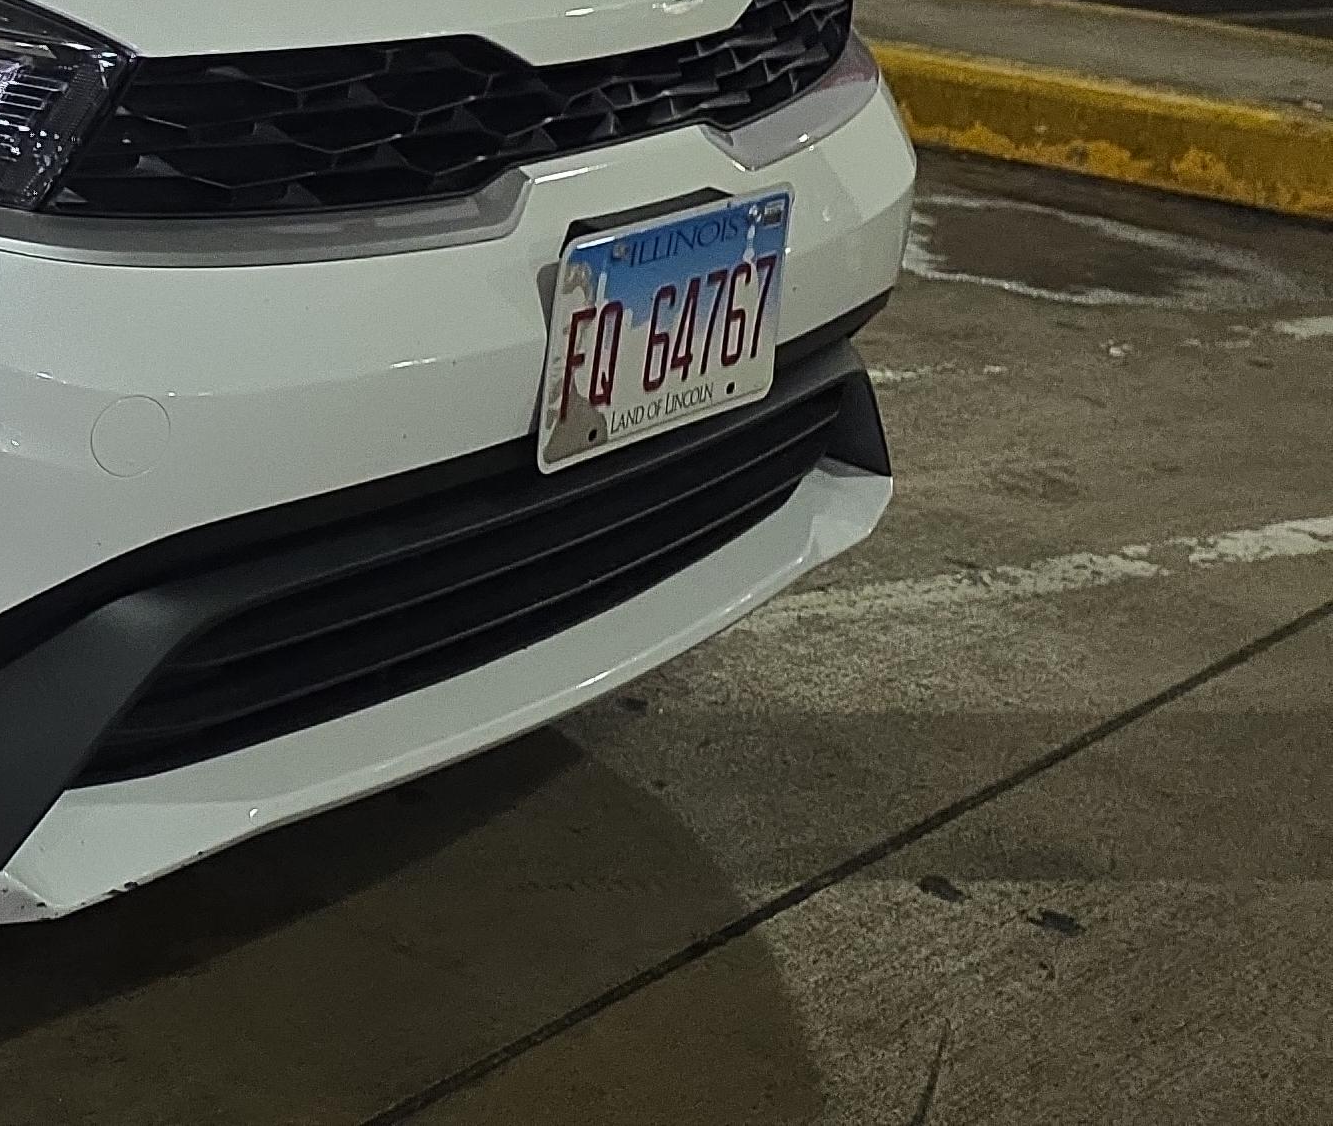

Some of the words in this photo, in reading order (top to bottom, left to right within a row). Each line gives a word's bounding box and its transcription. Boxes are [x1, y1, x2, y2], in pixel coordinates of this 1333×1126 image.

[629, 216, 739, 268] ILLINOIS
[559, 300, 624, 422] FQ
[642, 254, 778, 393] 64767
[610, 405, 645, 435] LAND
[646, 397, 664, 421] OF
[664, 382, 715, 416] LINCOLN
